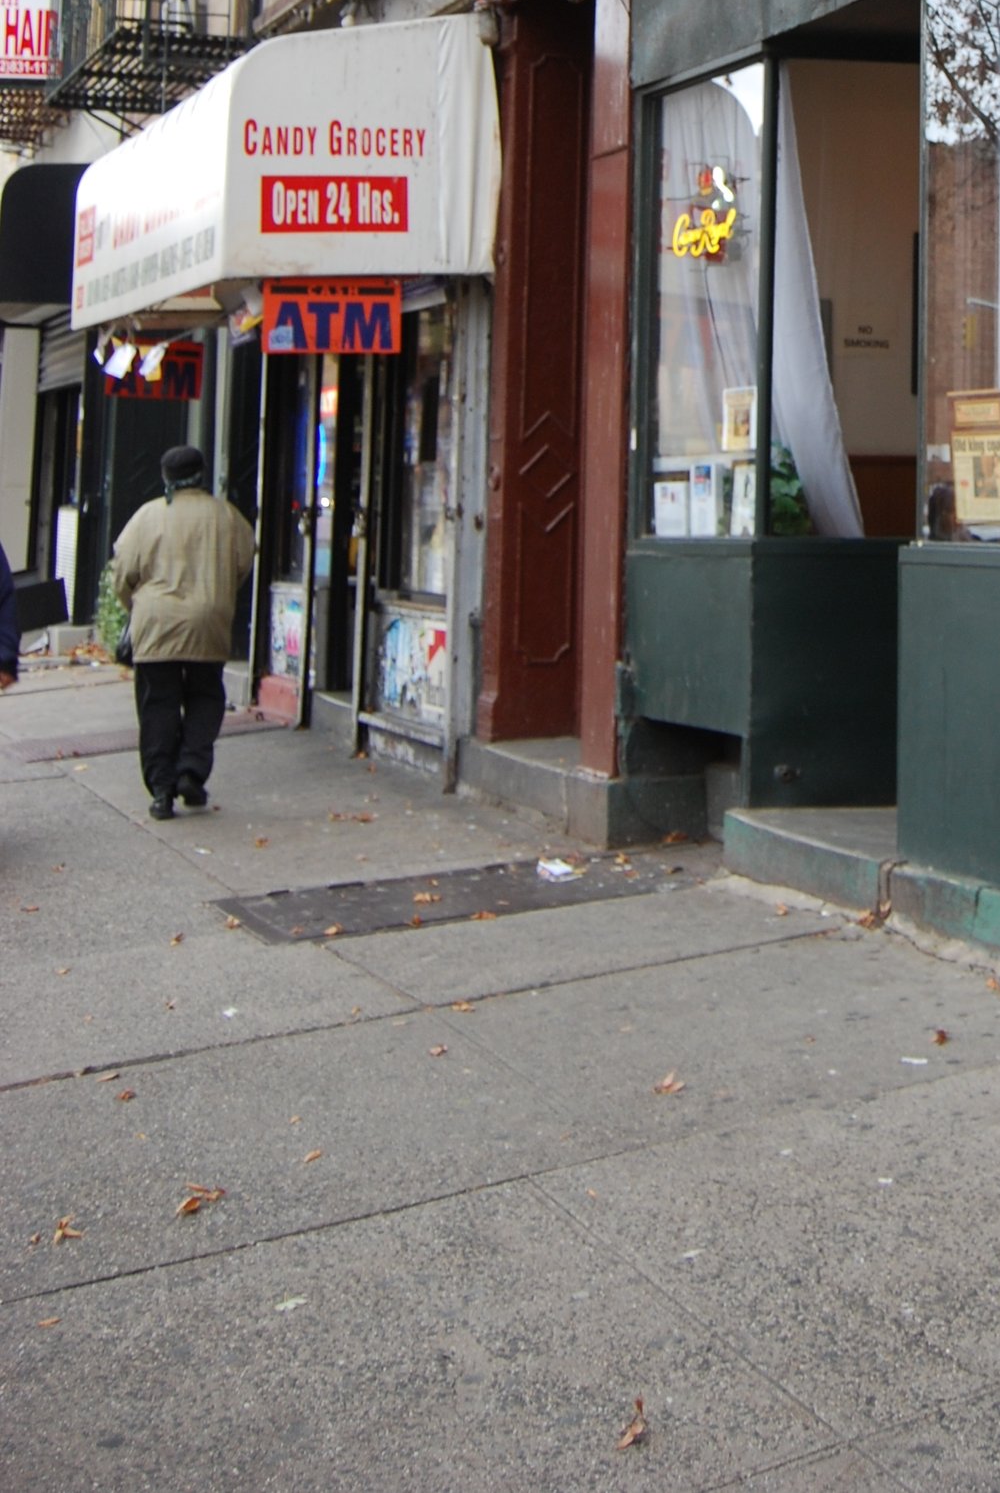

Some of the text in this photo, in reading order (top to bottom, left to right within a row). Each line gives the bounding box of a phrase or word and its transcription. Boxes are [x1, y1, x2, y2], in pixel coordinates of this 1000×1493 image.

[244, 118, 426, 157] CANDY GROCERY
[271, 180, 319, 225] OPEN
[325, 181, 351, 224] 24
[357, 181, 400, 225] HRS.
[273, 300, 394, 350] ATM
[843, 338, 890, 350] SMOKING
[857, 325, 873, 335] NO
